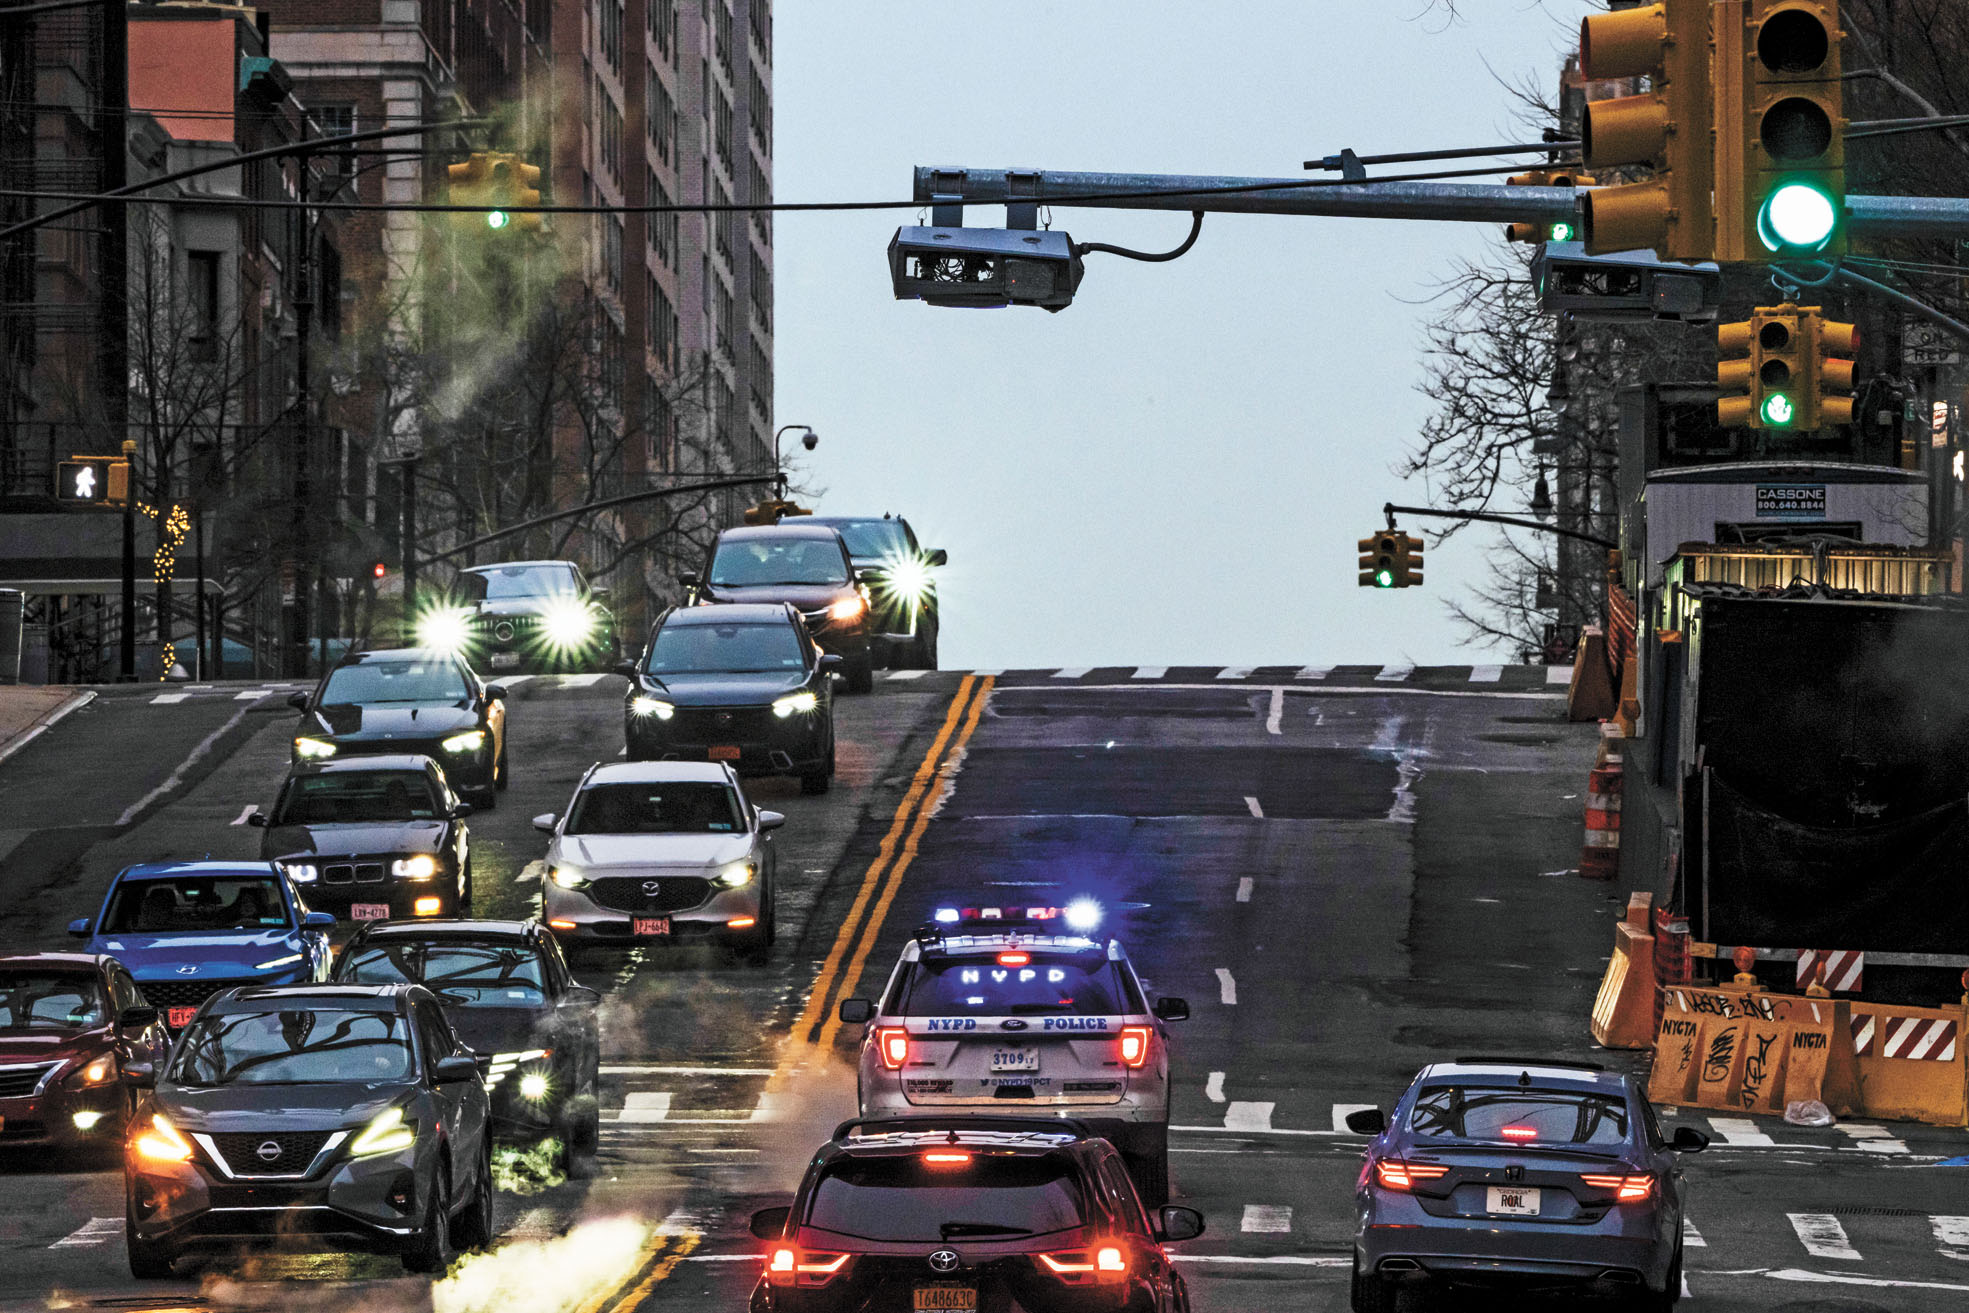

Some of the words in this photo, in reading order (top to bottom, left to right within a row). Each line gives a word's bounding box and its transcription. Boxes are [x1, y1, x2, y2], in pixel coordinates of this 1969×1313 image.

[1758, 490, 1824, 499] CASSONE
[1758, 501, 1824, 509] 800.640.8844
[962, 969, 1065, 984] NYPD
[928, 1019, 976, 1030] NYPD
[1043, 1018, 1107, 1029] POLICE
[1662, 1019, 1697, 1036] NYCTA
[1793, 1032, 1827, 1048] NYCTA
[993, 1053, 1024, 1065] 3709
[918, 1290, 973, 1307] T648663C
